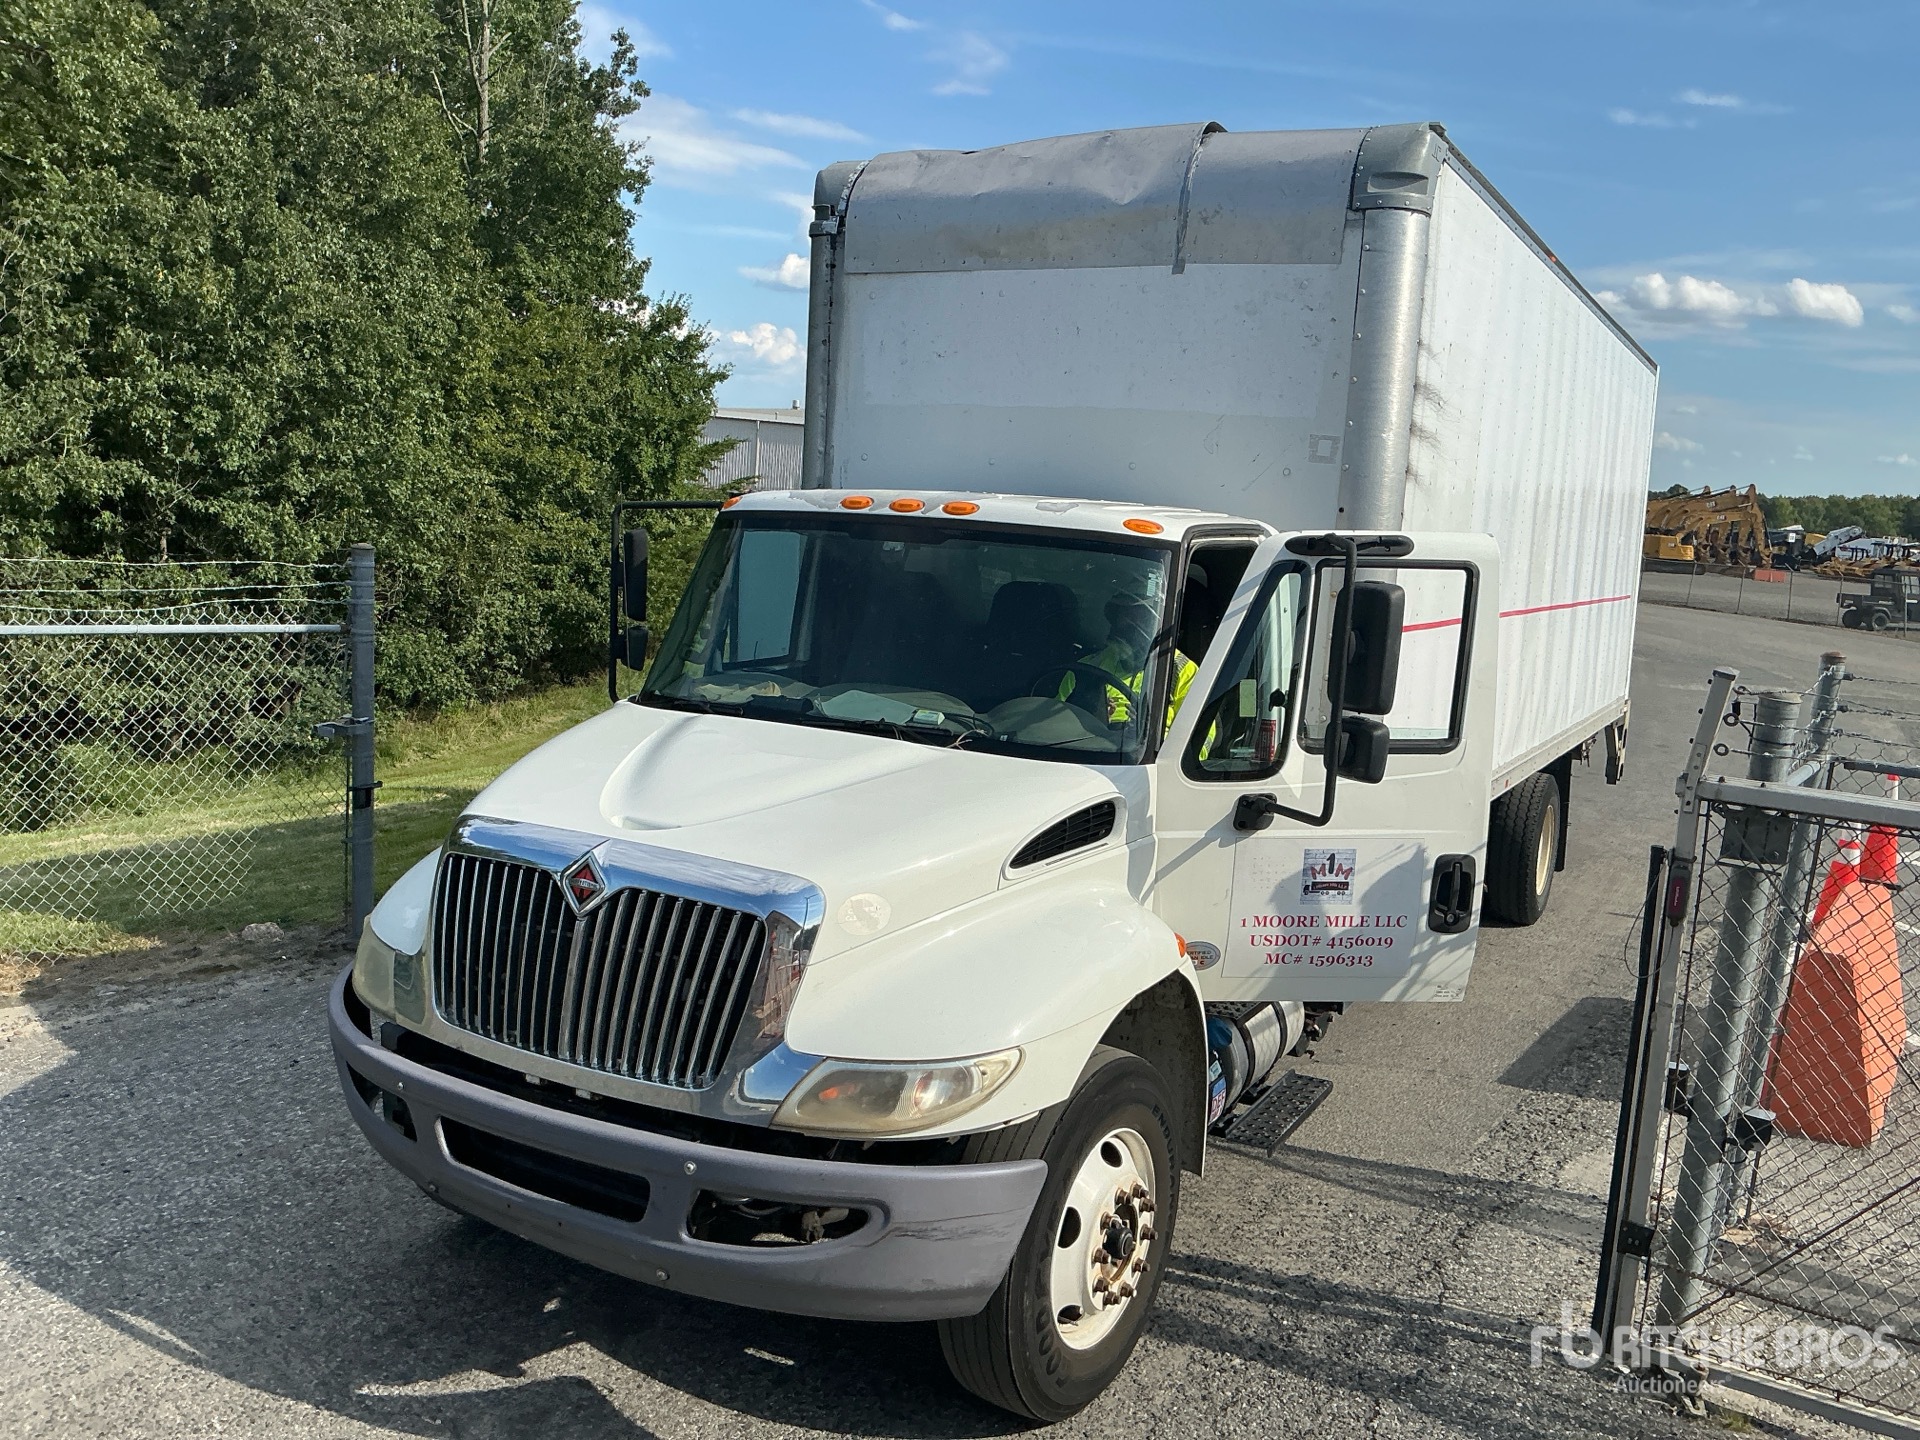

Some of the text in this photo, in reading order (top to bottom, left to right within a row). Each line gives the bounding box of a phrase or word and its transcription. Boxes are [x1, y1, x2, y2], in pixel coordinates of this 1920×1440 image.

[1240, 914, 1408, 928] 1 MOORE MILE LLC
[1250, 934, 1394, 949] USDOT# 4156019
[1264, 953, 1374, 967] MC# 1596313
